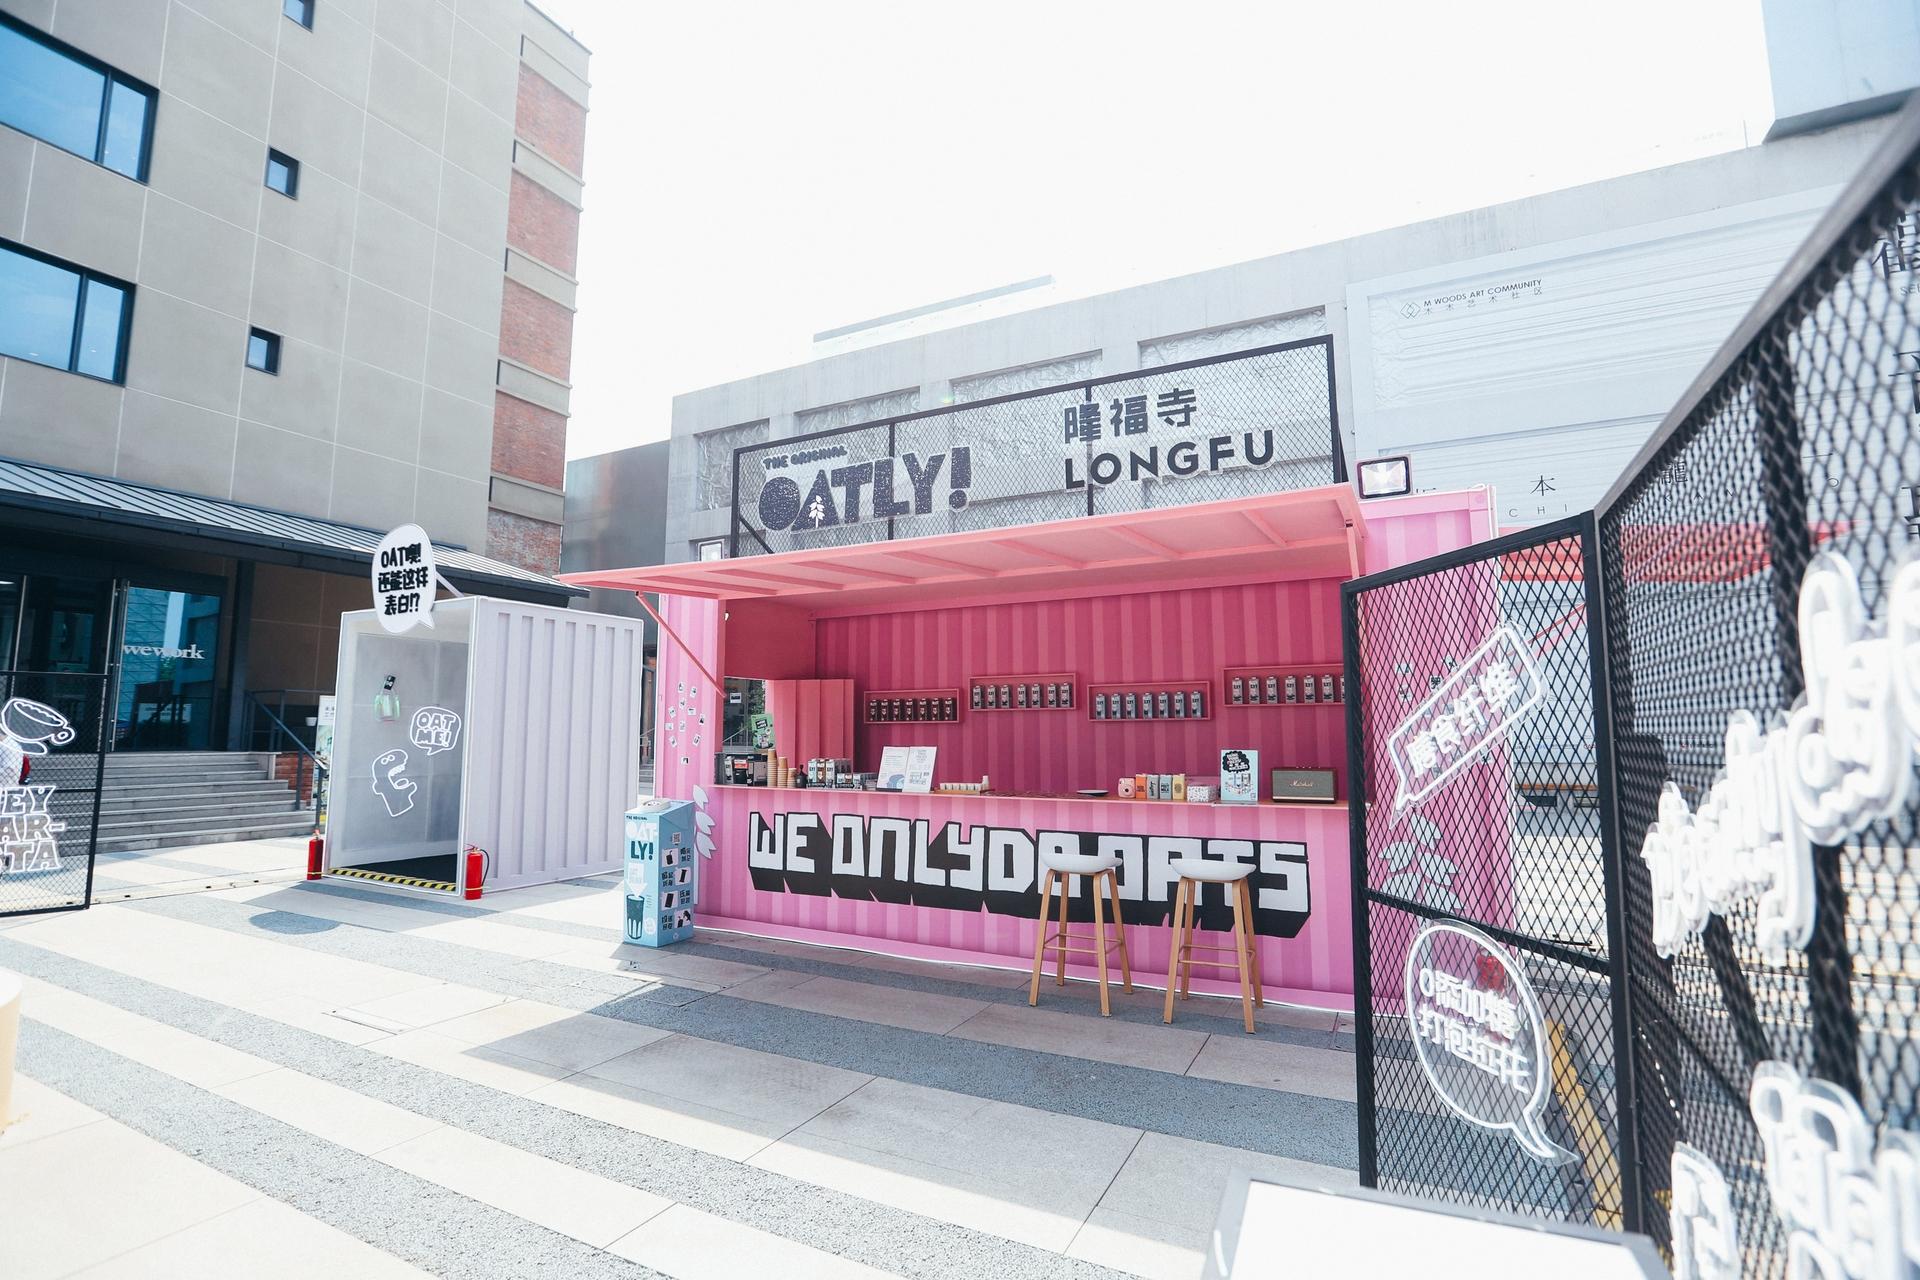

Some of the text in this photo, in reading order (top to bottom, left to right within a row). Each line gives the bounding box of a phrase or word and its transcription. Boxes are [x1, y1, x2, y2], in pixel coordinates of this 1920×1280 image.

[1423, 279, 1542, 308] M WOODS ART COMMUNITY
[1065, 388, 1197, 444] 隆福寺
[763, 445, 848, 470] THE ORIGINAL
[1065, 429, 1274, 489] LONGFU
[759, 446, 972, 532] OATLY!
[1530, 475, 1556, 497] 本
[378, 566, 429, 593] 还能这样
[123, 644, 206, 660] wework
[417, 711, 457, 731] OAT
[415, 729, 453, 748] ME!
[0, 785, 57, 815] EY
[0, 840, 62, 873] TA
[630, 840, 655, 861] LY!
[748, 811, 820, 873] WE
[831, 812, 987, 892] ONLY
